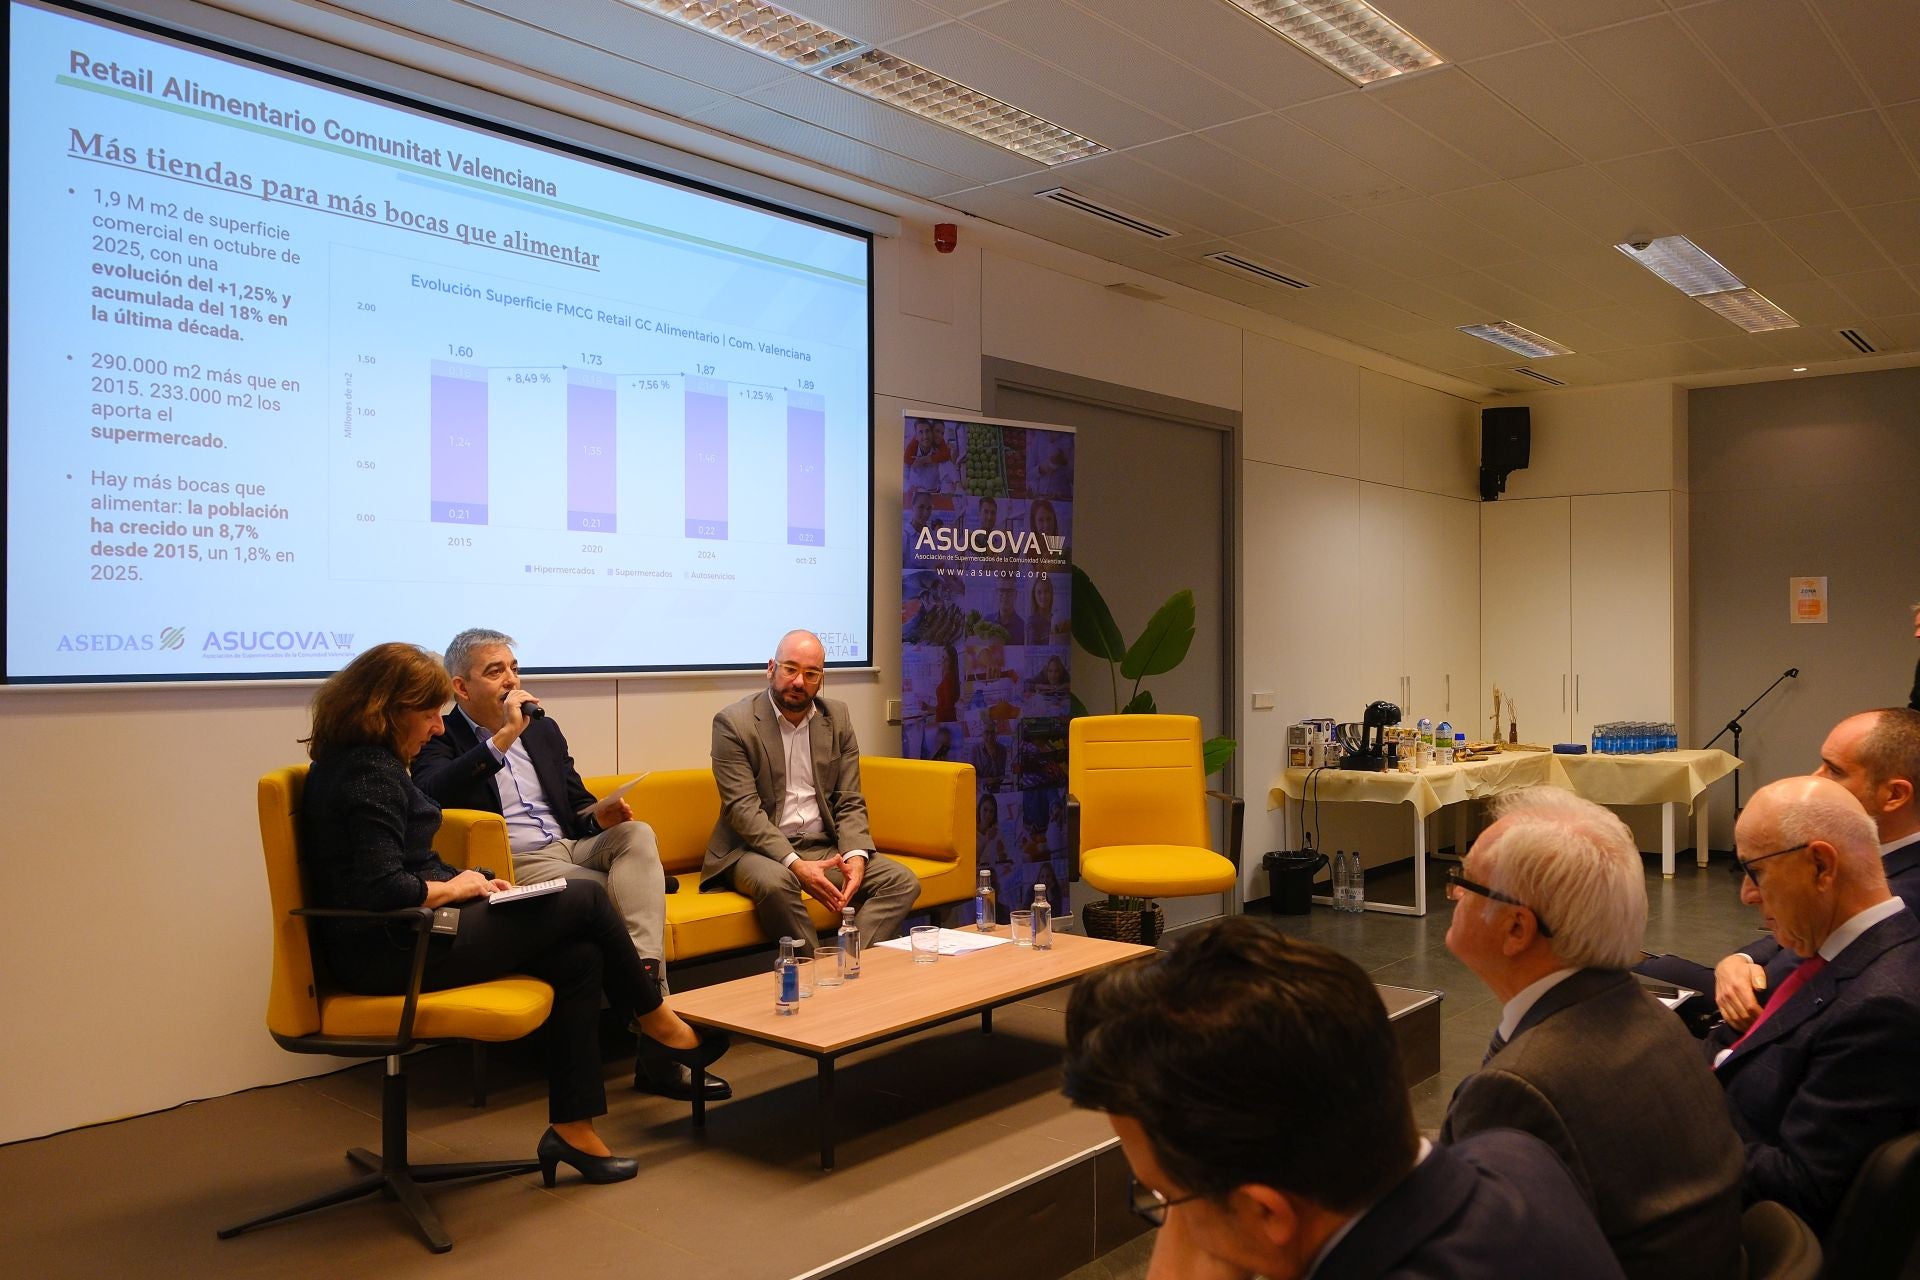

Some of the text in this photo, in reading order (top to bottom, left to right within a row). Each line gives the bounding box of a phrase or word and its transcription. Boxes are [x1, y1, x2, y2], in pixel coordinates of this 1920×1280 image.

[70, 50, 557, 197] Retail Alimentario Comunitat Valenciana
[68, 128, 600, 267] Más tiendas para más bocas que alimentar
[94, 188, 290, 241] 1,9 M m2 de superficie
[92, 215, 301, 264] comercial en octubre de
[91, 235, 218, 271] 2025, con una
[92, 261, 292, 309] evolución del +1,25% y
[92, 285, 288, 326] acumulada del 18% en
[92, 305, 244, 341] la última década.
[411, 274, 481, 300] Evolución
[486, 289, 552, 313] Superficie
[556, 303, 593, 321] FMCG
[597, 311, 631, 328] Retail
[635, 319, 652, 331] GC
[655, 322, 720, 345] Alimentario
[728, 337, 756, 352] Com.
[758, 342, 811, 362] Valenciana
[91, 353, 300, 392] 290.000 m2 más que en
[540, 373, 551, 384] %
[91, 377, 281, 411] 2015. 233.000 m2 los
[661, 380, 670, 390] %
[91, 402, 172, 422] aporta el
[344, 372, 353, 439] Millones de m2
[91, 425, 227, 449] supermercado.
[91, 470, 266, 498] Hay más bocas que
[91, 495, 289, 520] alimentar: la población
[91, 517, 259, 540] ha crecido un 8,7%
[91, 541, 294, 563] desde 2015, un 1,8% en
[447, 537, 472, 547] 2015
[582, 544, 603, 554] 2020
[915, 527, 1041, 554] ASUCOVA
[698, 551, 716, 560] 2024
[91, 565, 143, 581] 2025.
[533, 564, 595, 576] Hipermercados
[615, 568, 673, 579] Supermercados
[691, 571, 735, 581] Autoservicios
[936, 568, 1047, 581] www.asucova.org
[56, 635, 153, 651] ASEDAS
[202, 631, 329, 651] ASUCOVA
[825, 646, 849, 656] ATA
